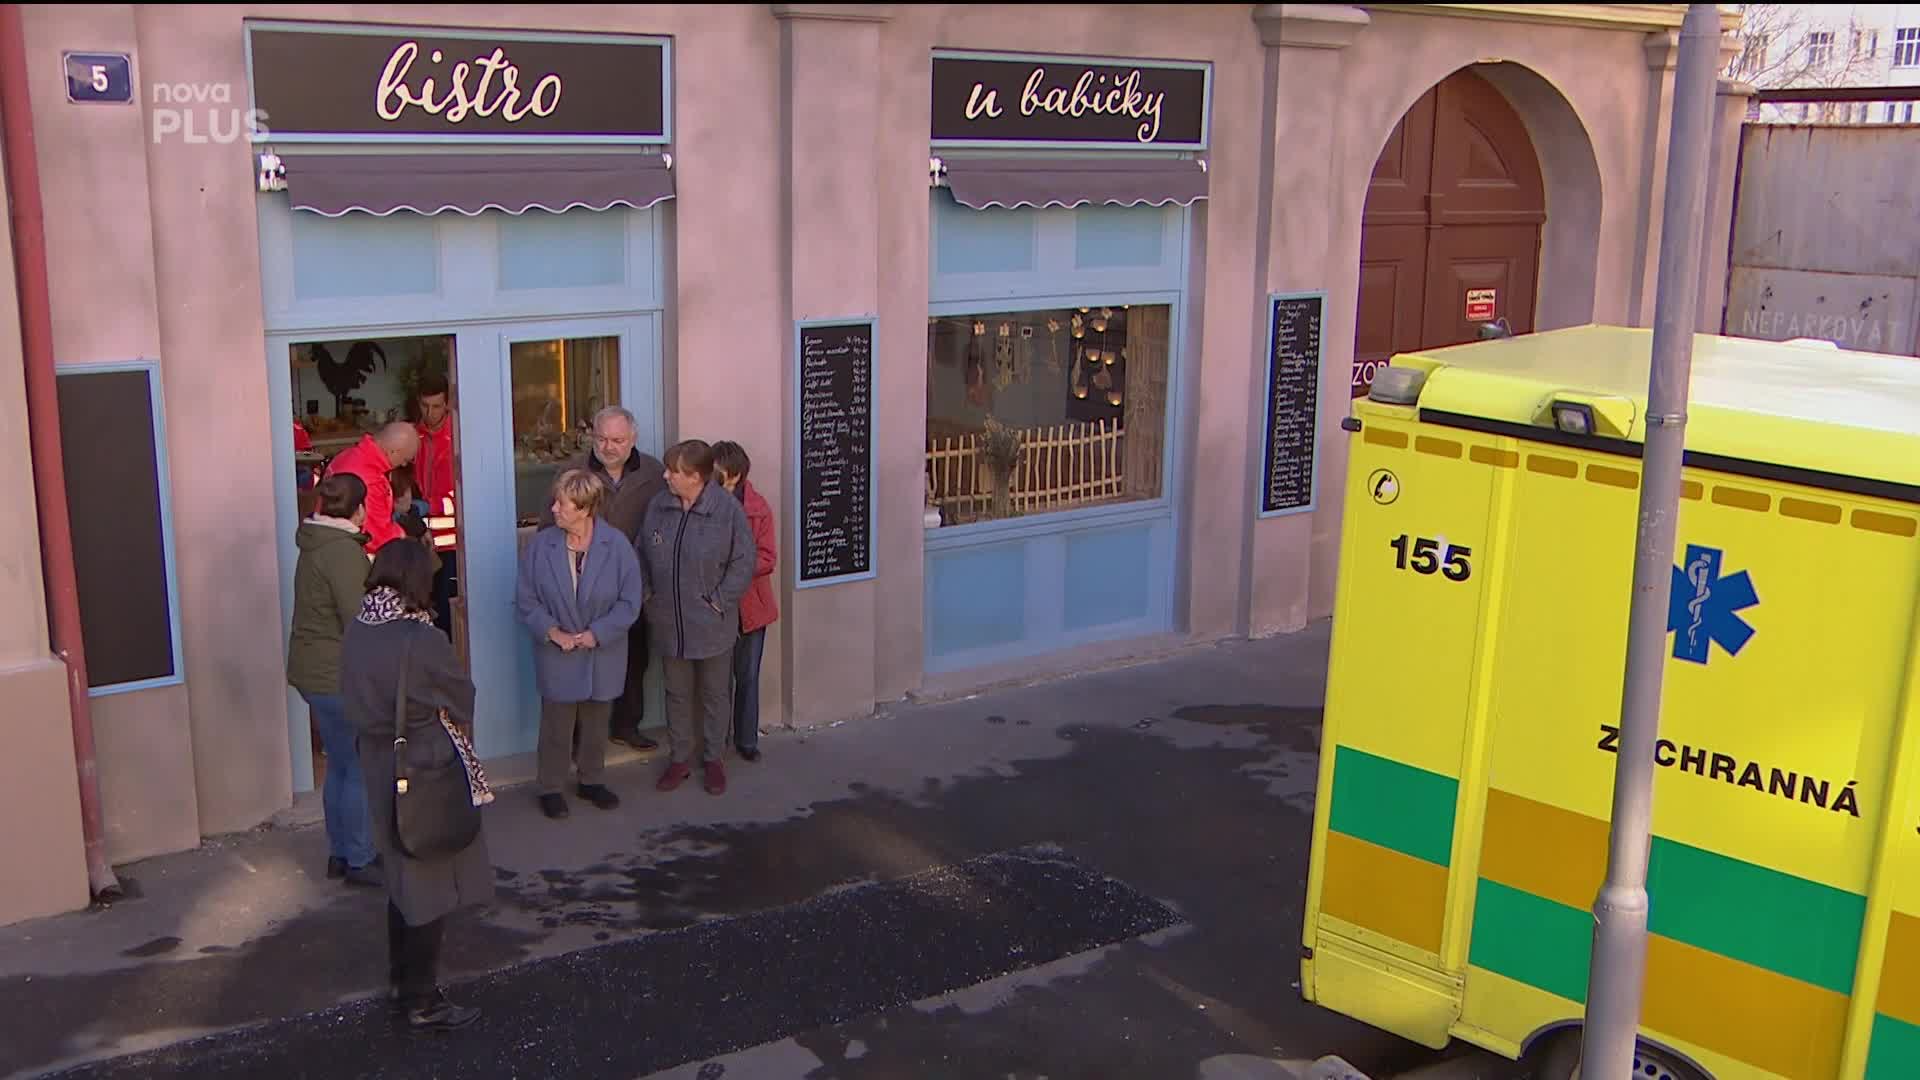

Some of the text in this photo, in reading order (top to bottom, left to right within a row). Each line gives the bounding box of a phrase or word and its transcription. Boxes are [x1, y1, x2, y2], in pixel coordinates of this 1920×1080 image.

[91, 65, 108, 91] 5
[376, 42, 562, 122] bistro
[965, 68, 1165, 142] u babičky
[1391, 534, 1471, 581] 155
[1598, 724, 1860, 818] ZCHRANNÁ
